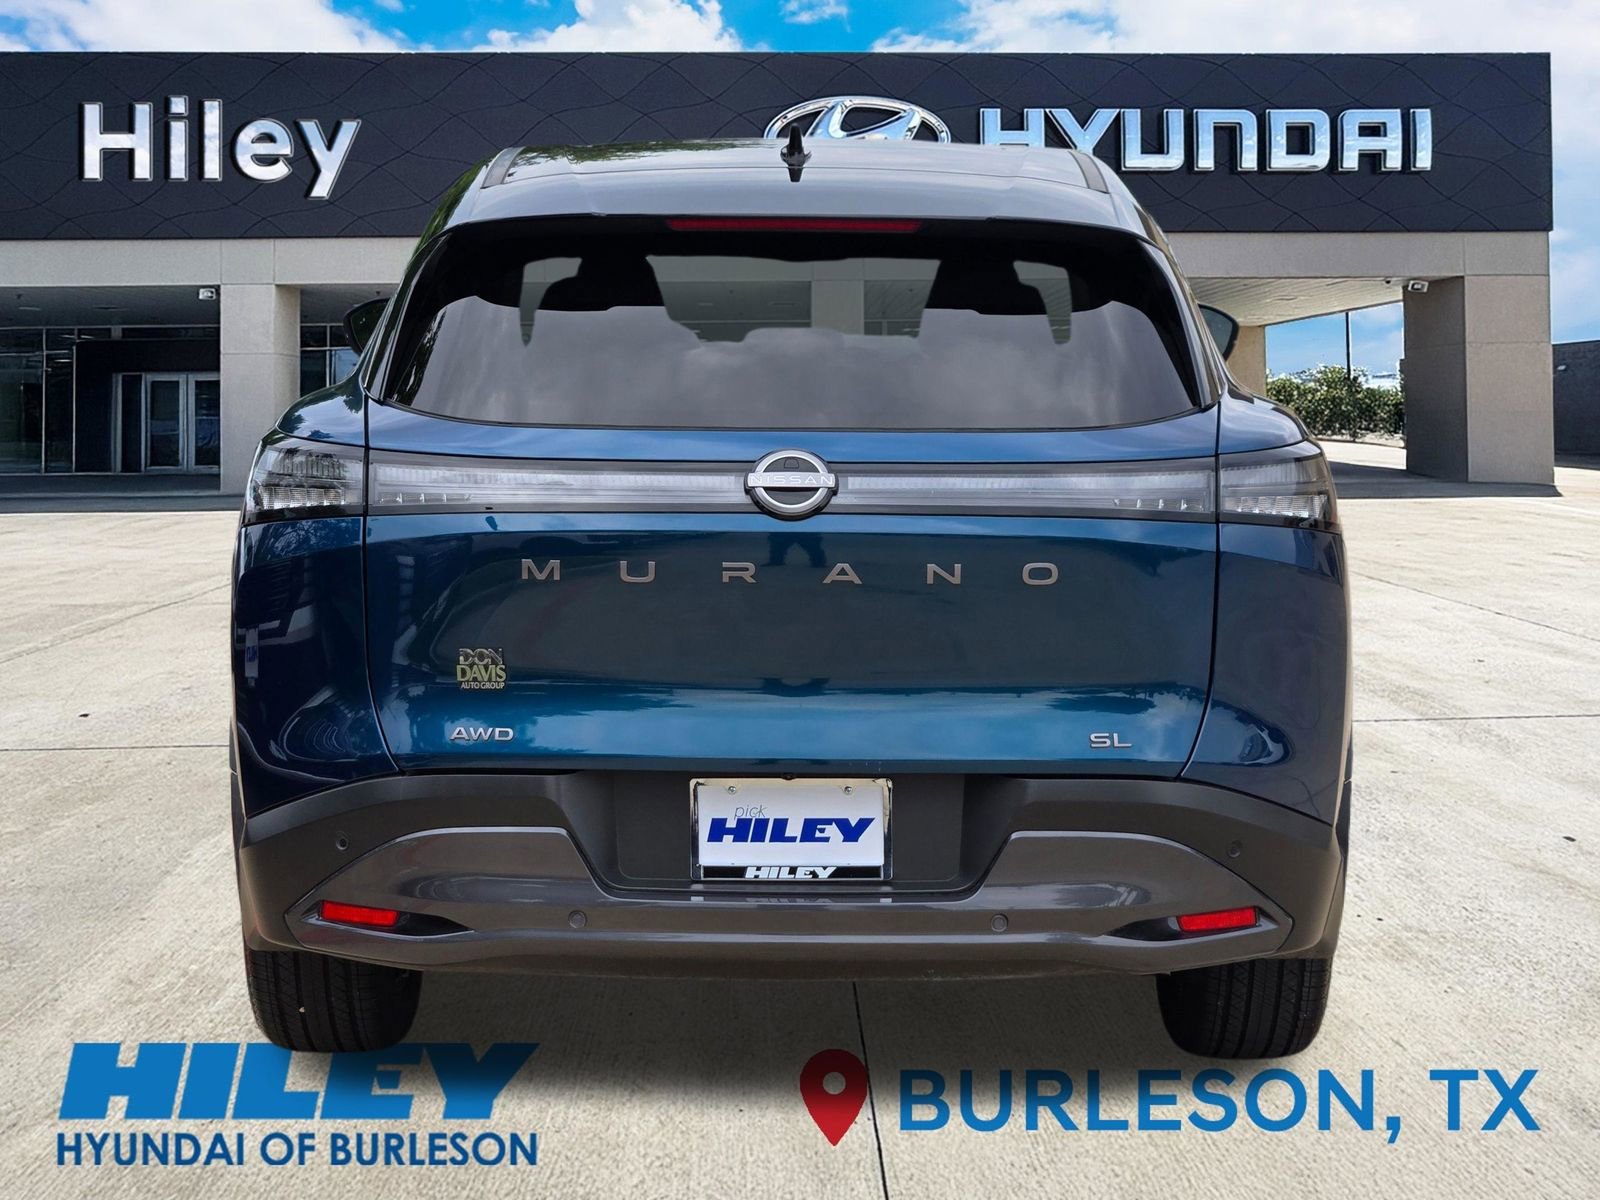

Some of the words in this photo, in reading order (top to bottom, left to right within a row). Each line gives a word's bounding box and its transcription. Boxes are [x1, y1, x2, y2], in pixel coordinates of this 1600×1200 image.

[79, 95, 361, 199] Hiley
[979, 107, 1433, 172] HYUNDAI
[750, 474, 833, 485] NISSAN
[520, 558, 1060, 586] MURANO
[458, 647, 504, 665] DON
[456, 664, 507, 682] DAVIS
[460, 681, 480, 690] AUTO
[480, 681, 505, 690] GROUP
[449, 726, 515, 741] AWD
[1089, 732, 1133, 749] SL
[733, 804, 768, 820] pick
[706, 817, 876, 843] HILEY
[743, 866, 838, 879] HILEY
